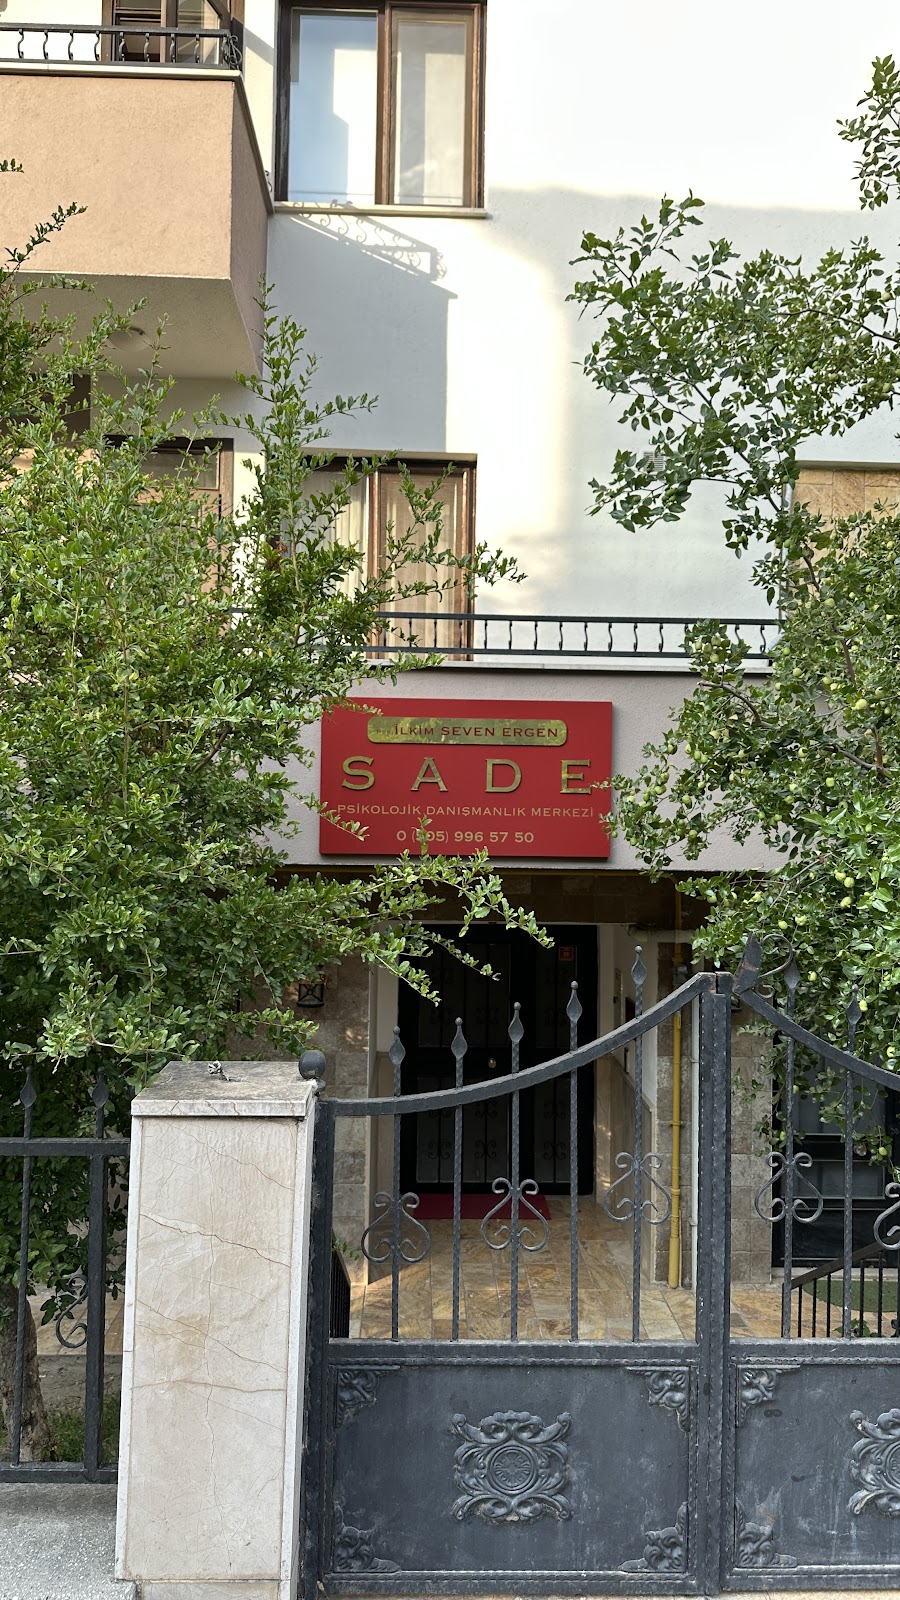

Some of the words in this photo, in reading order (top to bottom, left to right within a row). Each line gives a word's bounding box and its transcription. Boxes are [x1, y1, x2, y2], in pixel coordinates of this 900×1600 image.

[395, 724, 434, 736] İLKİM
[441, 726, 495, 737] SEVEN
[502, 727, 558, 738] ERGEN
[341, 756, 592, 795] SADE
[337, 803, 421, 815] PSİKOLOJİK
[426, 806, 526, 817] DANIŞMANLIK
[531, 807, 594, 818] MERKEZİ
[396, 830, 407, 841] 0
[411, 830, 449, 843] (05)
[454, 831, 484, 842] 996
[489, 832, 509, 843] 57
[514, 832, 535, 843] 50
